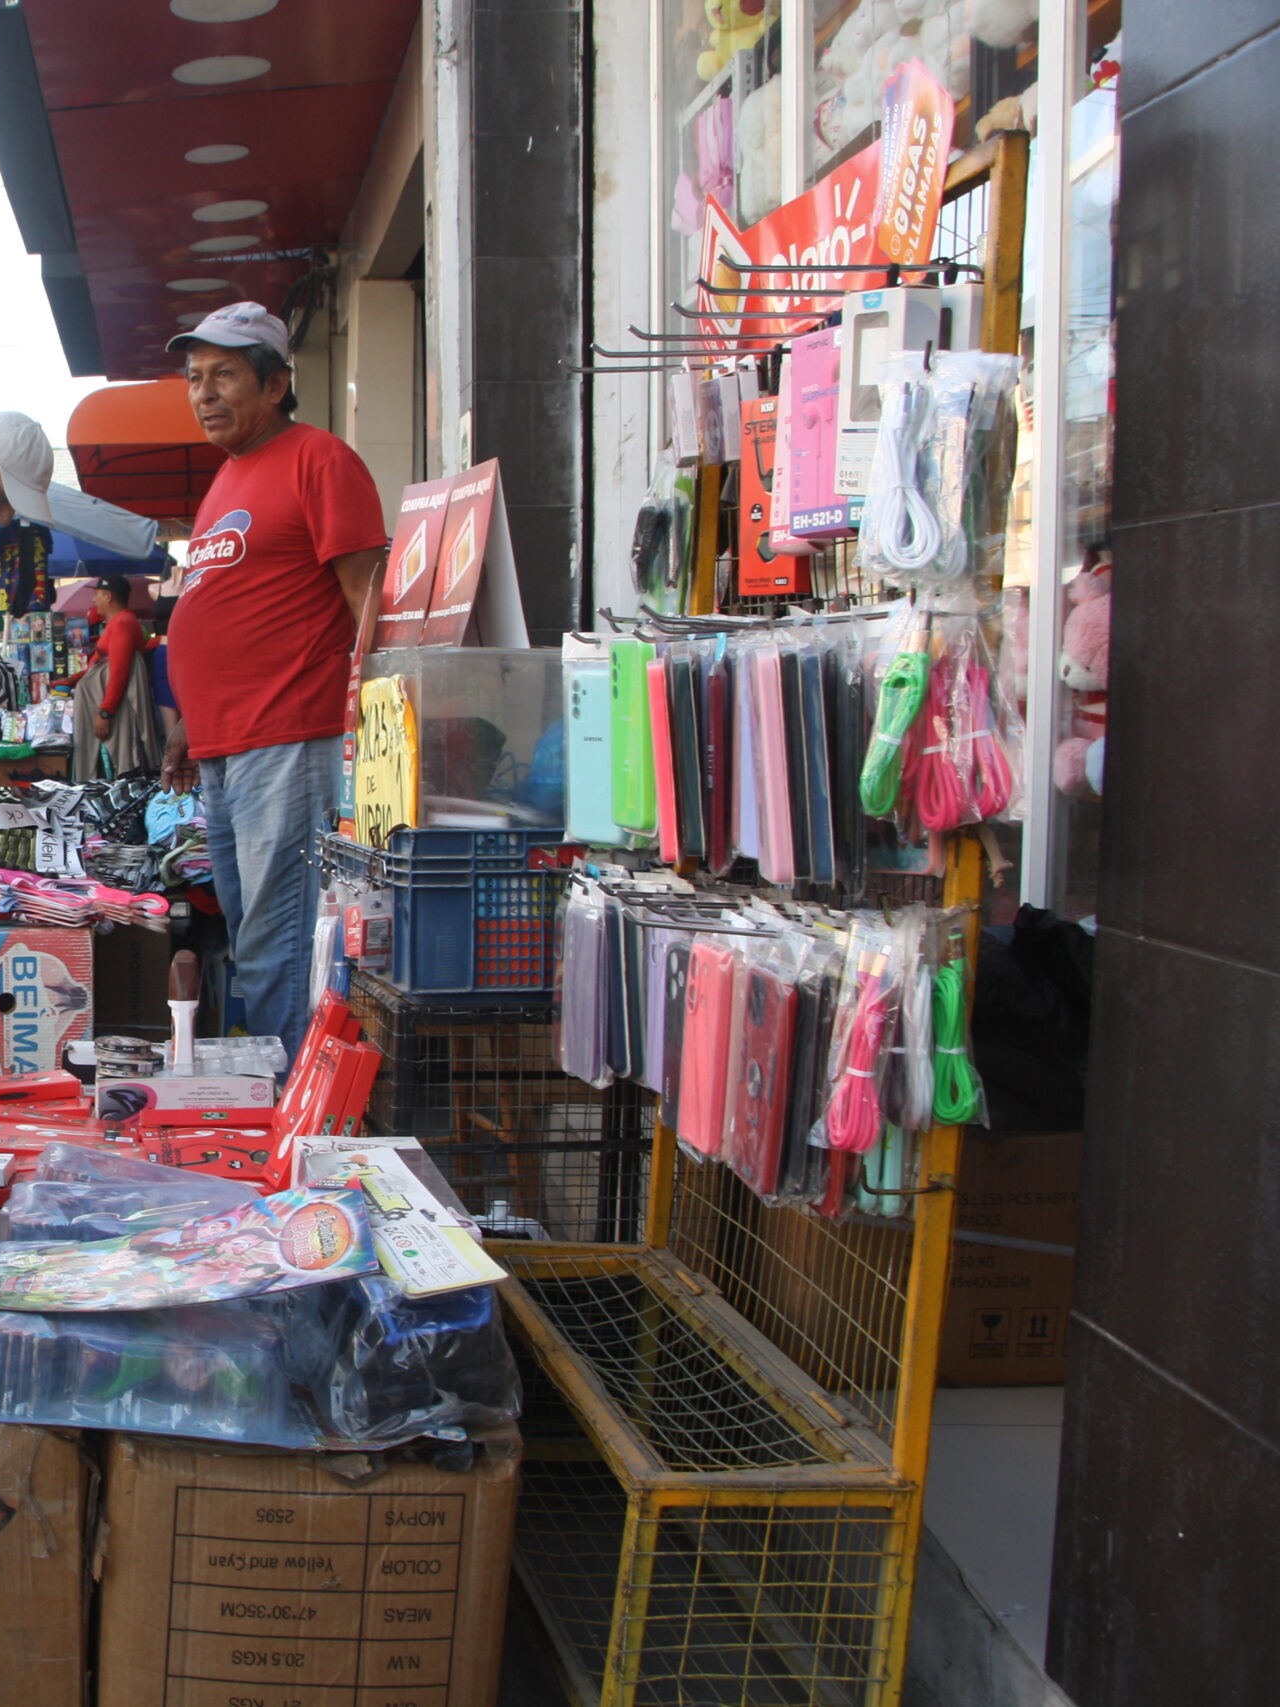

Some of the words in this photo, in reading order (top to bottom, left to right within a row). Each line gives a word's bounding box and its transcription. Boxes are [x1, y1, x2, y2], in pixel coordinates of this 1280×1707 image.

[891, 114, 928, 237] GIGAS
[906, 112, 944, 251] LLAMADAS
[401, 496, 431, 513] COMPRA
[793, 510, 843, 530] EH-521-D
[366, 775, 377, 795] DE
[41, 832, 59, 863] Klein
[256, 1508, 296, 1524] 2595
[384, 1510, 446, 1527] MOPYS
[208, 1554, 248, 1571] Cyan
[249, 1555, 279, 1570] and
[284, 1556, 334, 1571] Yellow
[381, 1558, 442, 1575] COLOR
[384, 1607, 432, 1622] MEAS
[231, 1650, 268, 1666] KGS
[272, 1652, 305, 1668] 20.5
[387, 1654, 420, 1670] N.W
